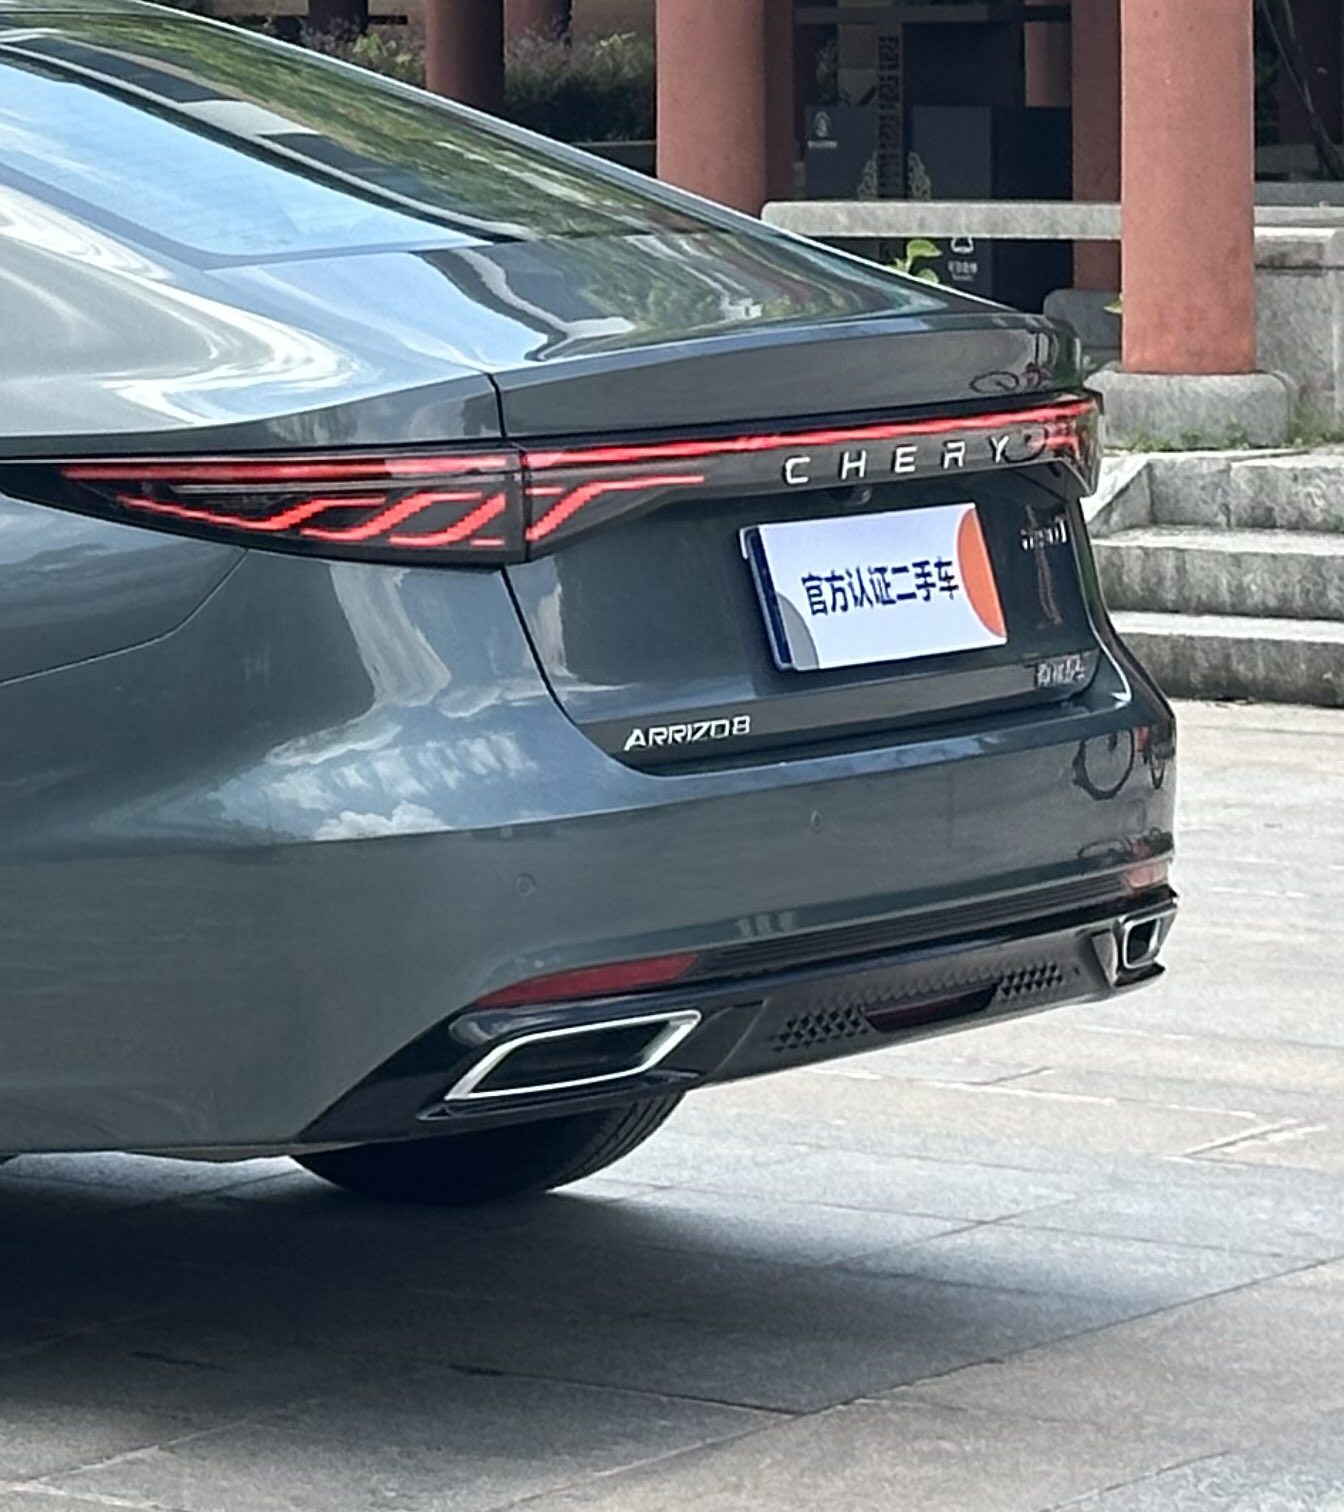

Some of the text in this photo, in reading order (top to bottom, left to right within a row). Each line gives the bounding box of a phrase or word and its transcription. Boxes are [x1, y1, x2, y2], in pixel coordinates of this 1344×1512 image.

[784, 435, 1010, 485] CHERY
[801, 556, 960, 616] 官方认证二手车
